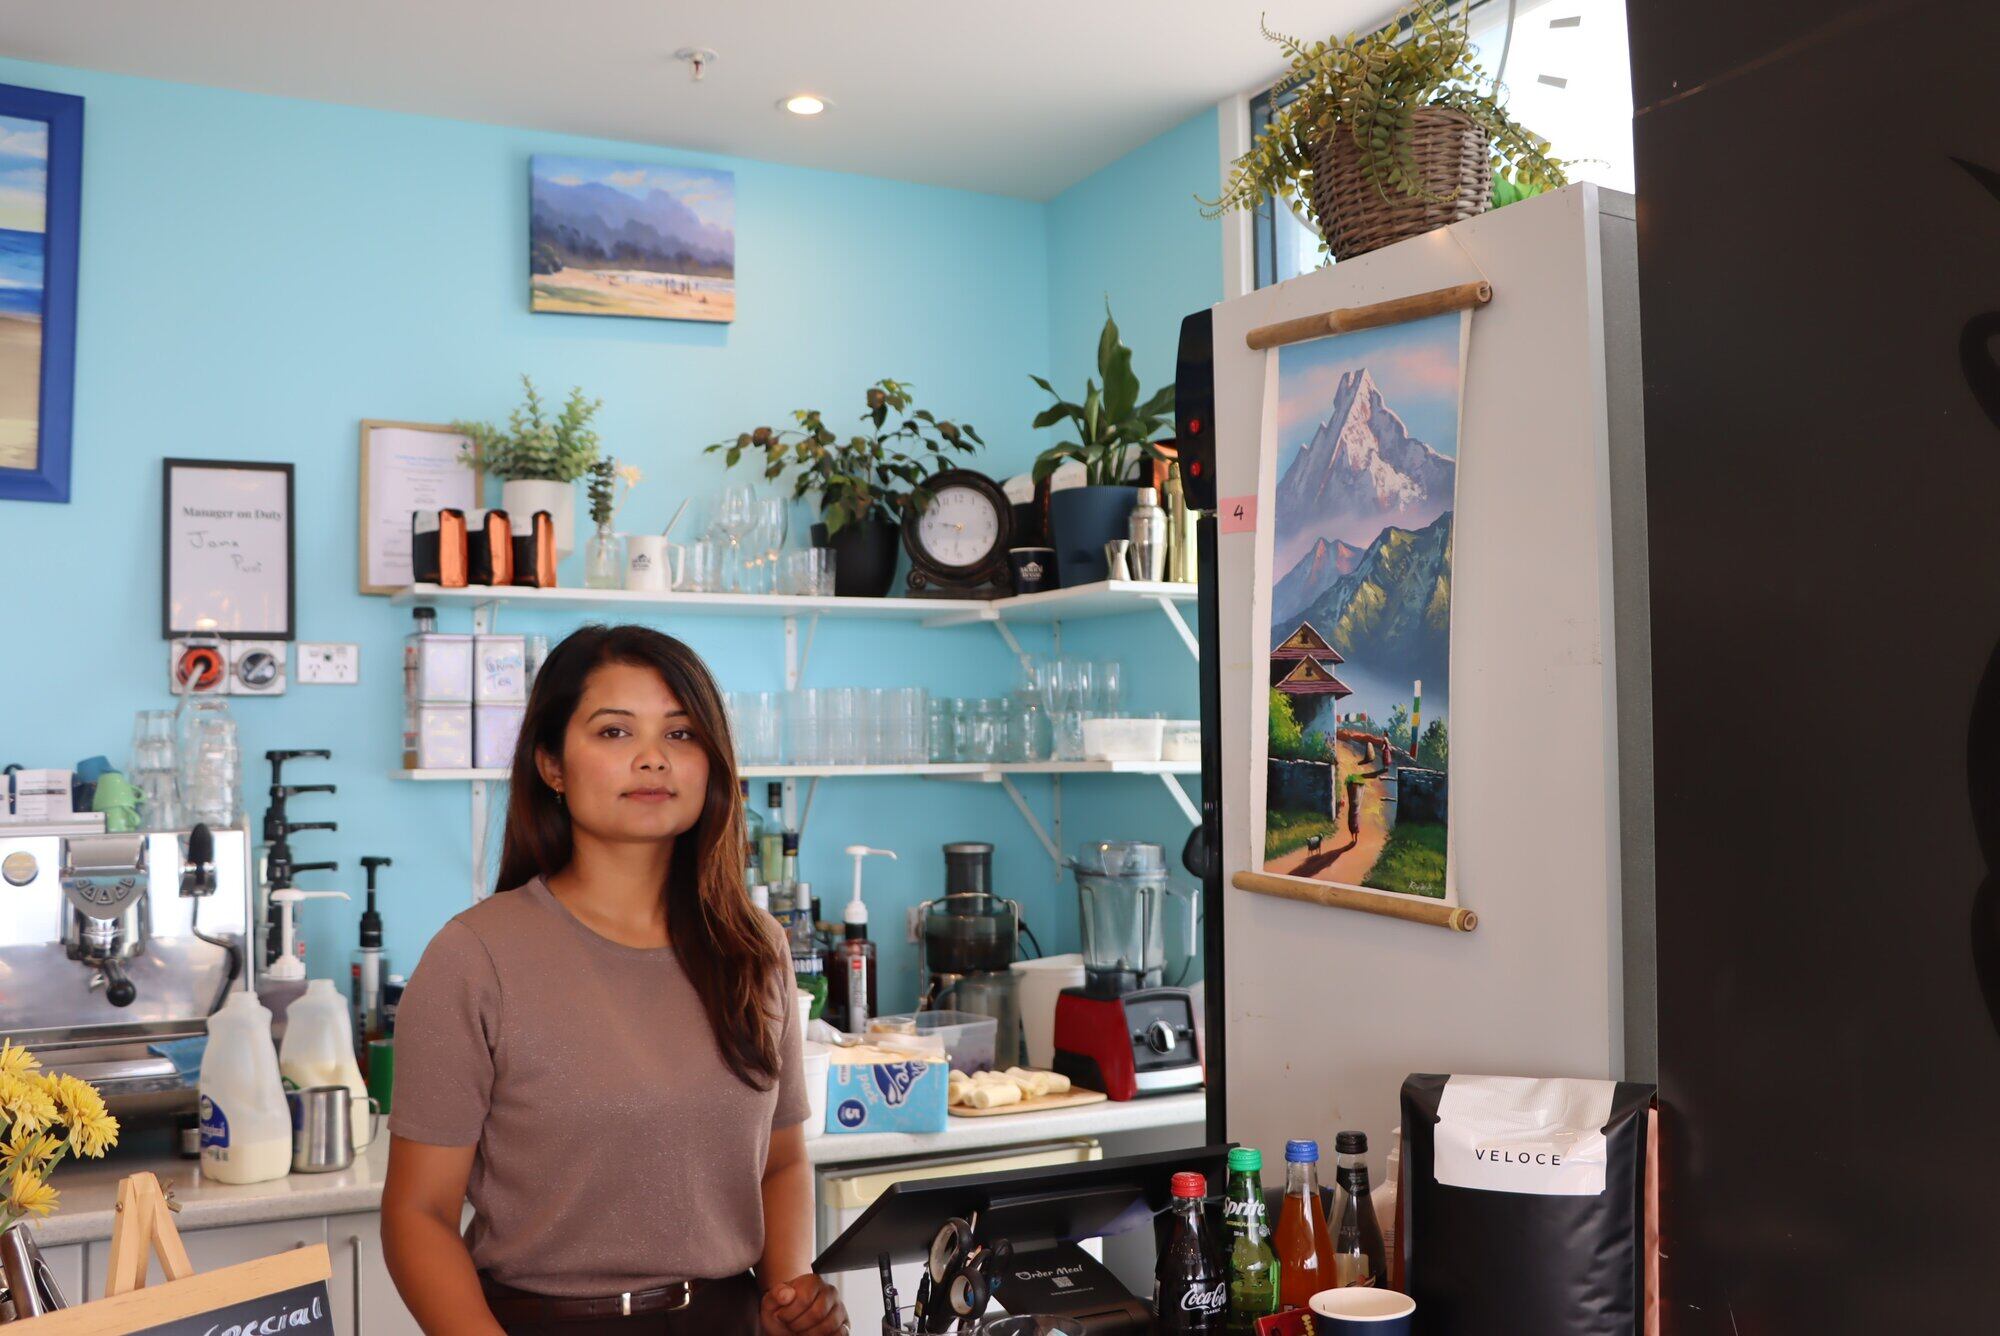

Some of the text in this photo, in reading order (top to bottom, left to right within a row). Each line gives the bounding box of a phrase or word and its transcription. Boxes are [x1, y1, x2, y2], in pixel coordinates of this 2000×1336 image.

[183, 506, 282, 522] Manager on Duty
[1233, 504, 1244, 521] 4
[844, 1107, 861, 1120] 5
[1475, 1148, 1561, 1166] VELOCE
[1223, 1196, 1266, 1218] Sprite
[1015, 1264, 1083, 1281] Order Meal
